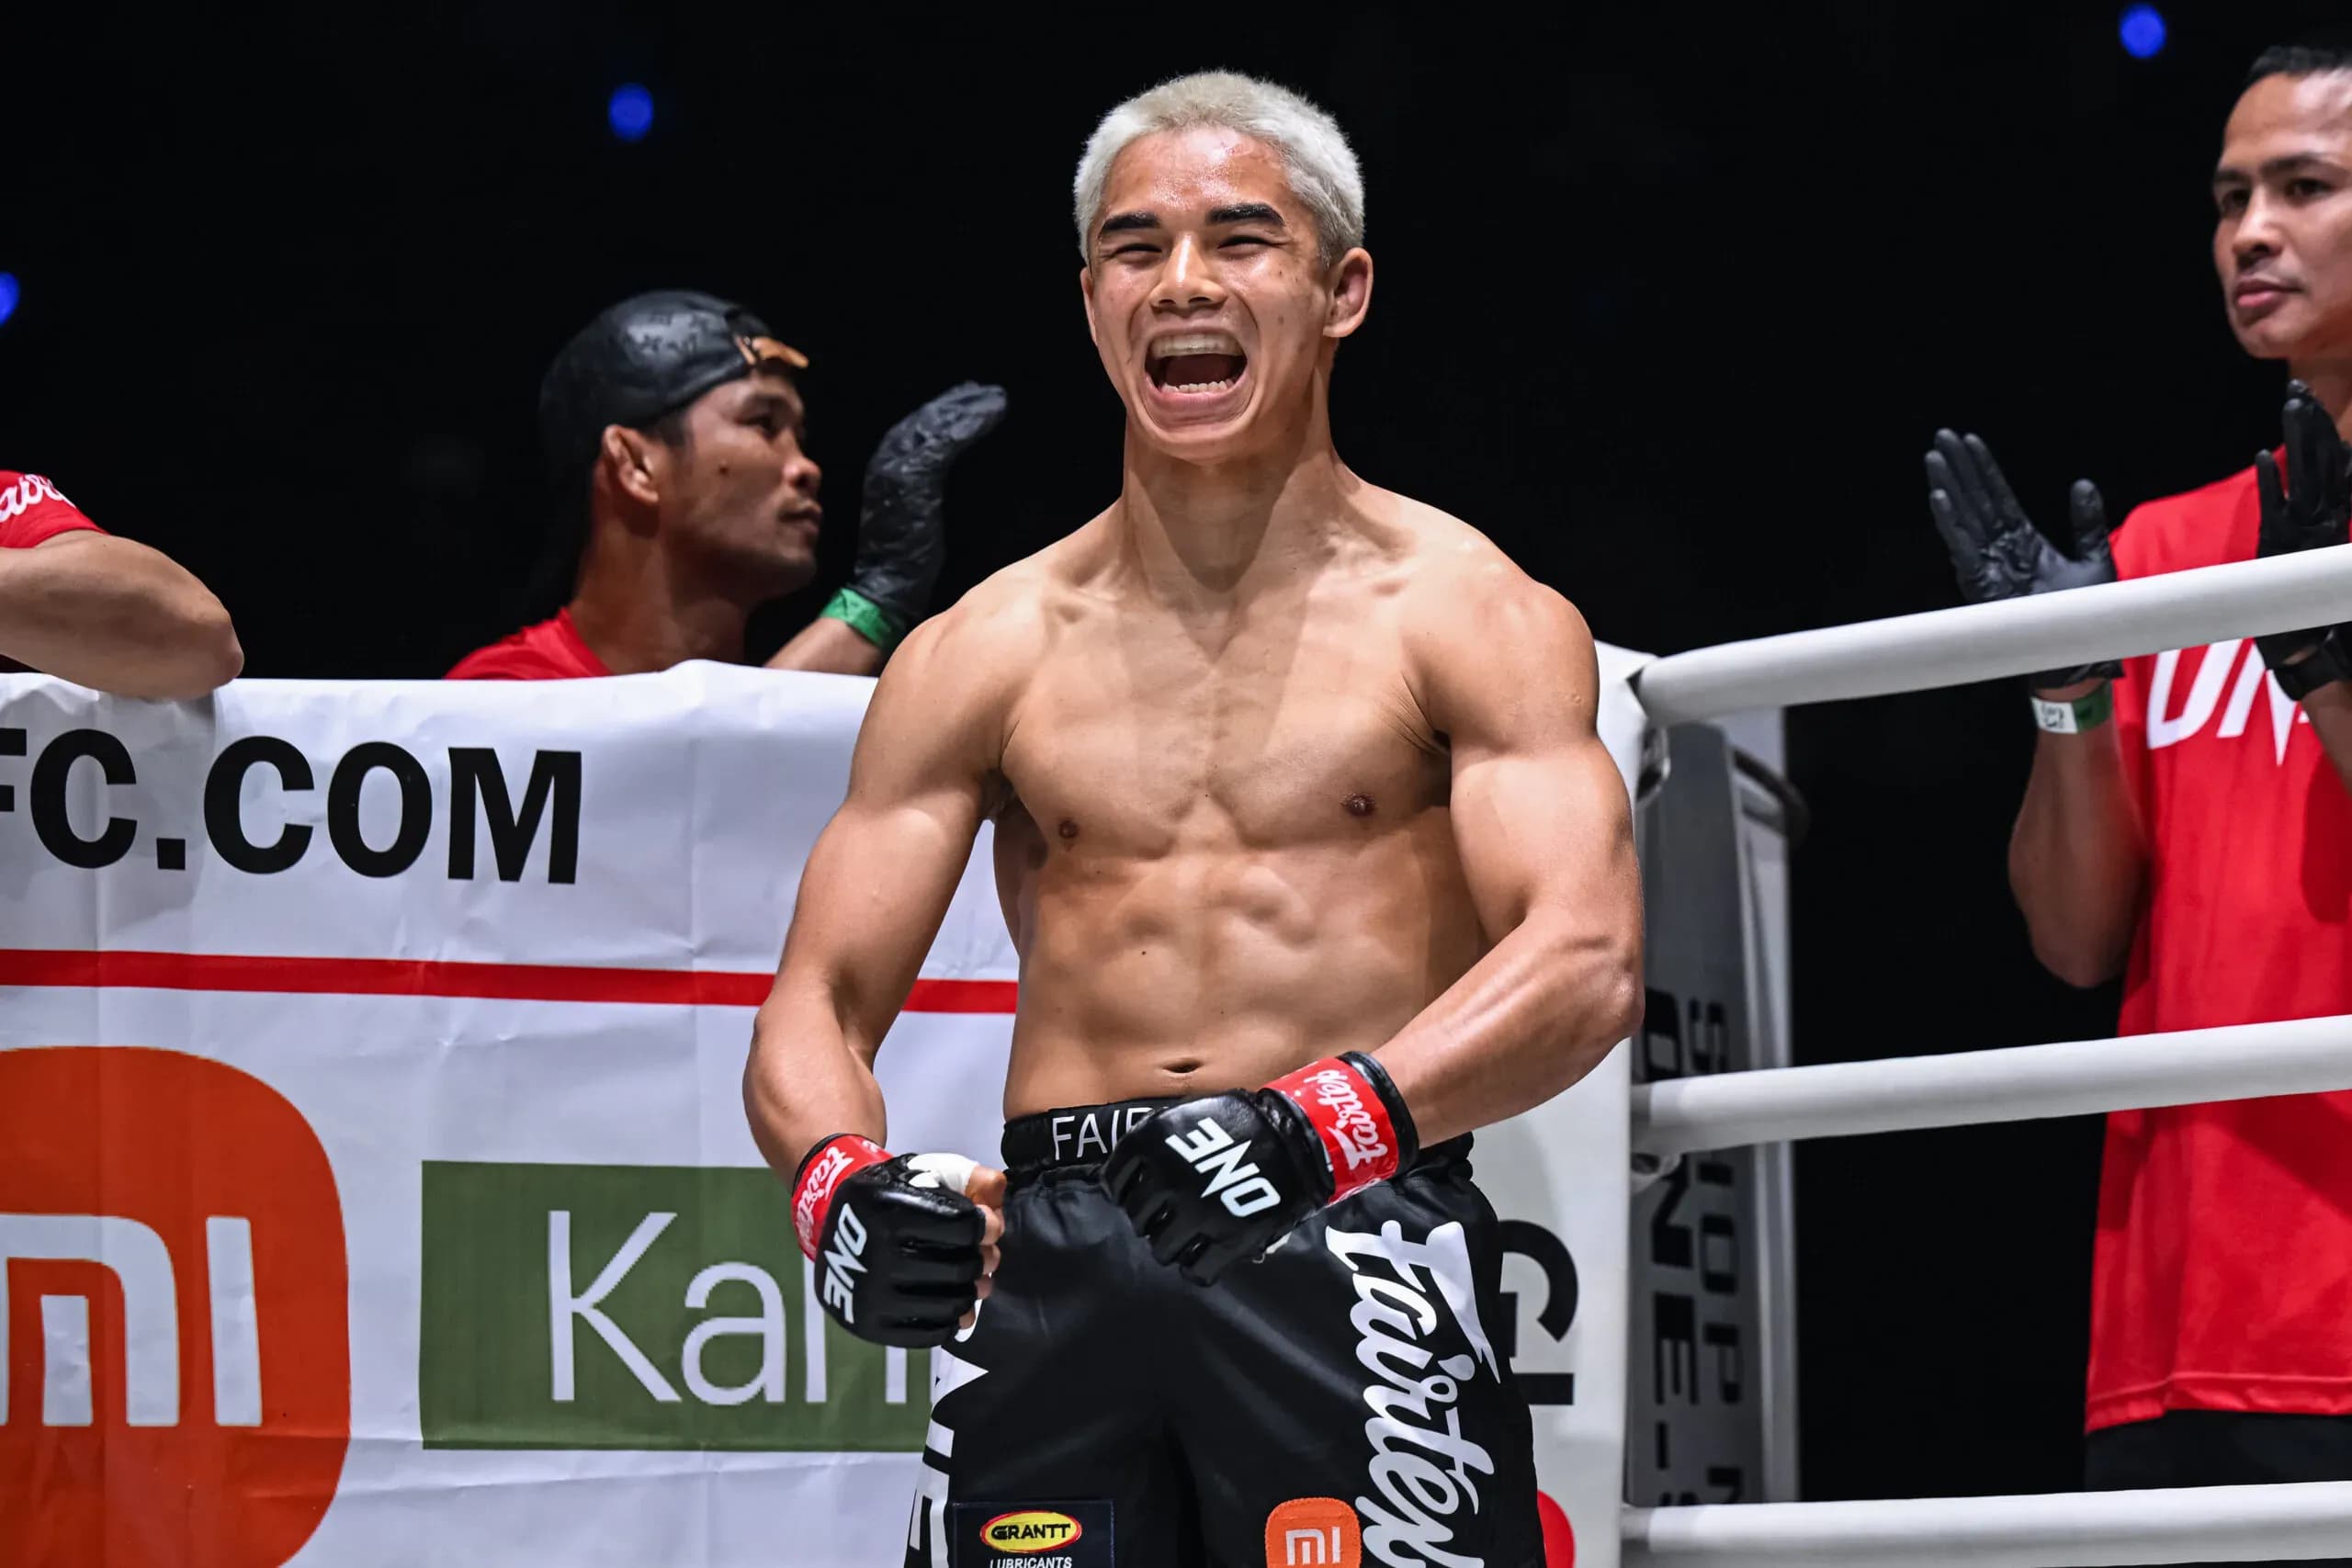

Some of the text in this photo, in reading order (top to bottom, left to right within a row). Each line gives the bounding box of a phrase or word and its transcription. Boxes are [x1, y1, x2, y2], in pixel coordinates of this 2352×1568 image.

[1164, 1117, 1282, 1218] ONE
[823, 1202, 868, 1325] ONE
[1325, 1220, 1501, 1568] Fairtex
[991, 1523, 1071, 1540] GRANTT
